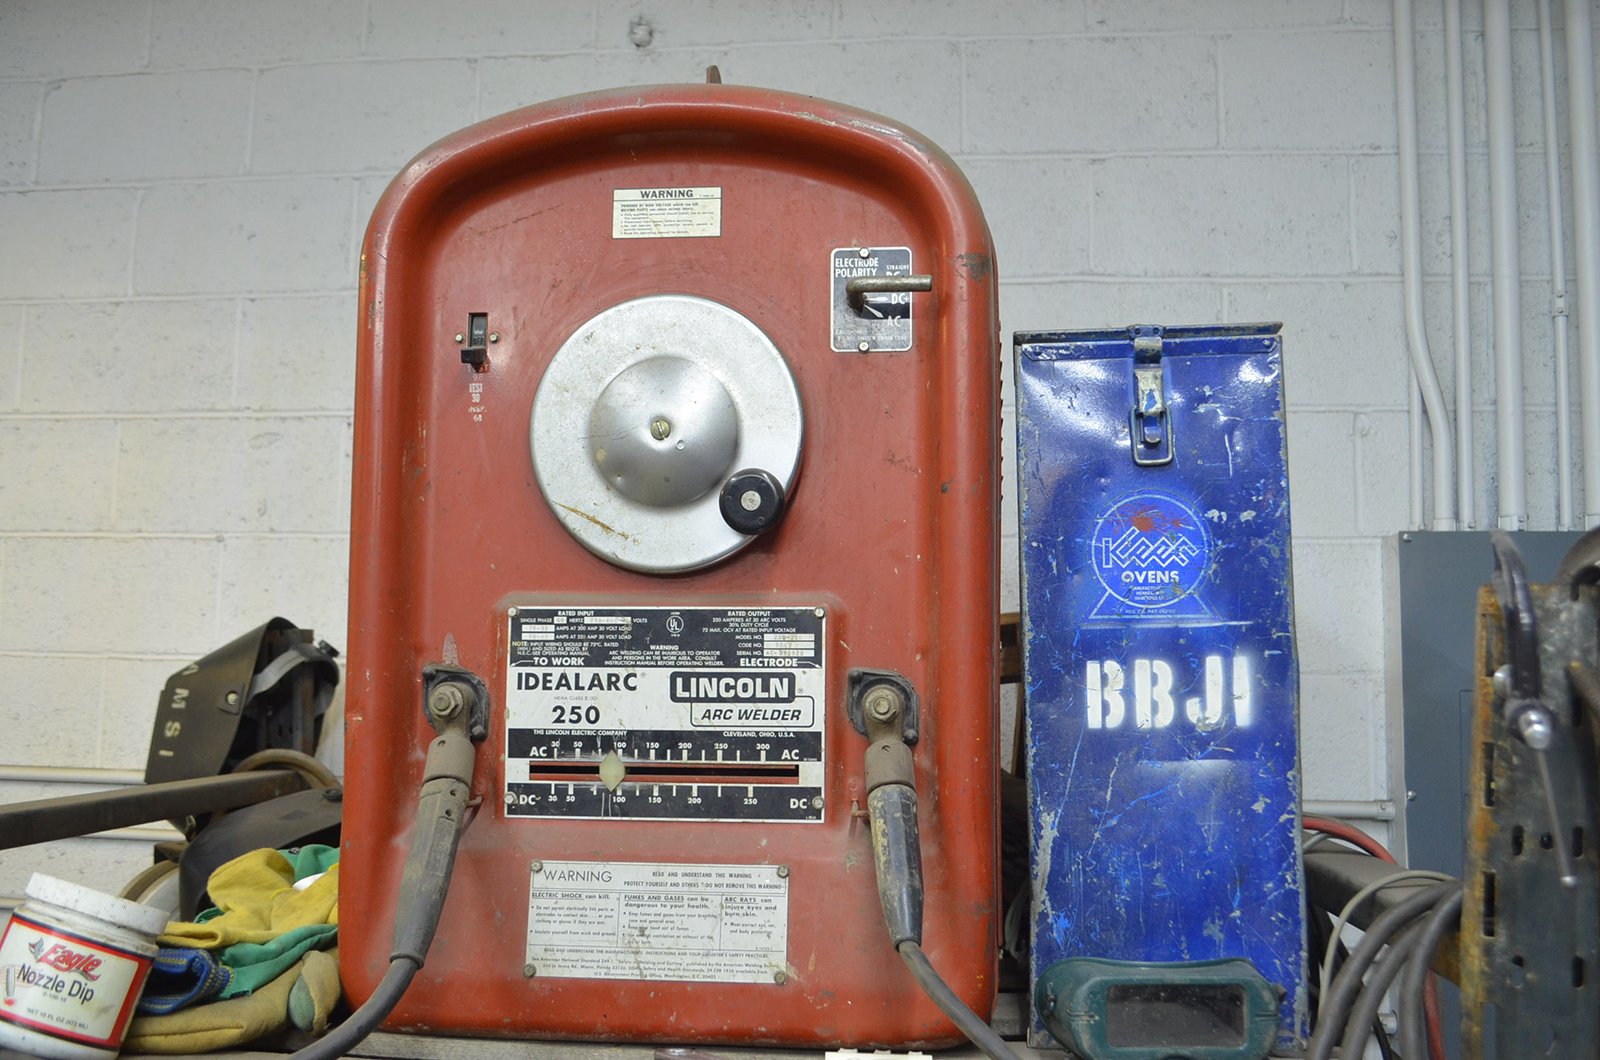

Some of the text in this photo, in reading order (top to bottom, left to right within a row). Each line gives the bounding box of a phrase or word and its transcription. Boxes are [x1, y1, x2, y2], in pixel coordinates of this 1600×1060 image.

[640, 189, 694, 199] WARNING
[835, 258, 879, 267] ELECTRODE
[835, 268, 877, 277] POLARITY
[891, 293, 909, 304] DC+
[886, 316, 901, 326] AC
[466, 364, 489, 372] TST
[1121, 570, 1179, 583] OVENS
[533, 657, 584, 666] TO WORK
[740, 658, 798, 667] ELECTRODE
[517, 672, 637, 691] IDEALARC
[676, 677, 788, 698] LINCOLN
[552, 705, 600, 724] 250
[701, 709, 801, 720] ARC WELDER
[530, 746, 547, 756] AC
[781, 750, 799, 760] AC
[519, 795, 536, 805] DC
[790, 799, 807, 809] DC
[544, 870, 612, 882] WARNING
[36, 944, 103, 981] Eagle
[16, 963, 94, 1005] Nozzle Dip
[27, 1007, 38, 1015] NET
